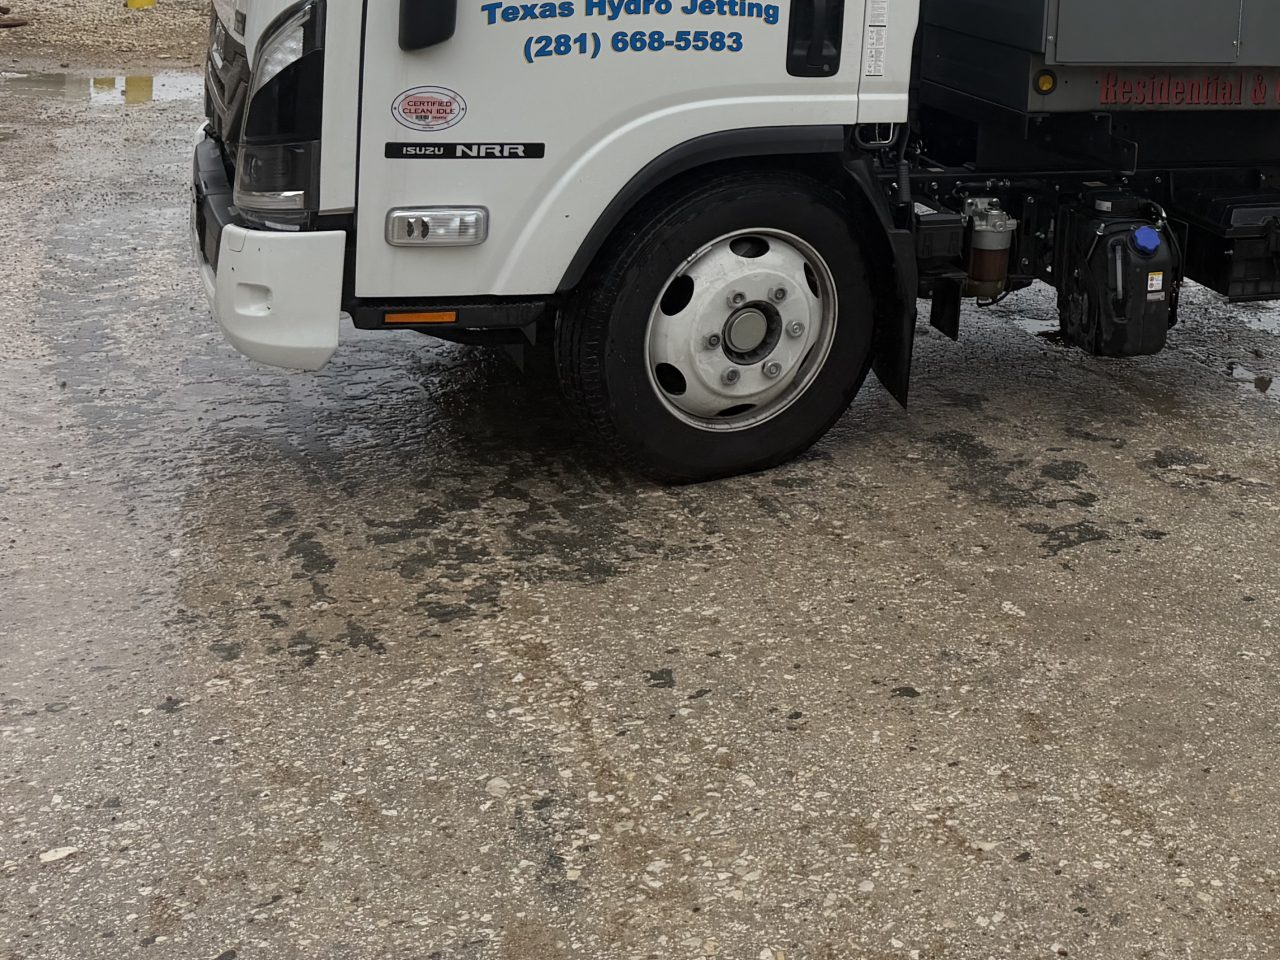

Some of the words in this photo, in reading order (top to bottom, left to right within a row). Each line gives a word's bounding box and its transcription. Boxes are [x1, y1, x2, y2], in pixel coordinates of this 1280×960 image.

[481, 0, 575, 26] Texas
[523, 32, 602, 64] (281)
[611, 30, 743, 53] 668-5583
[1099, 72, 1243, 106] Residential
[1250, 74, 1267, 106] &
[402, 107, 433, 115] CLEAN
[407, 100, 452, 108] CERTIFIED
[402, 146, 444, 155] ISUZU
[455, 144, 525, 157] NRR
